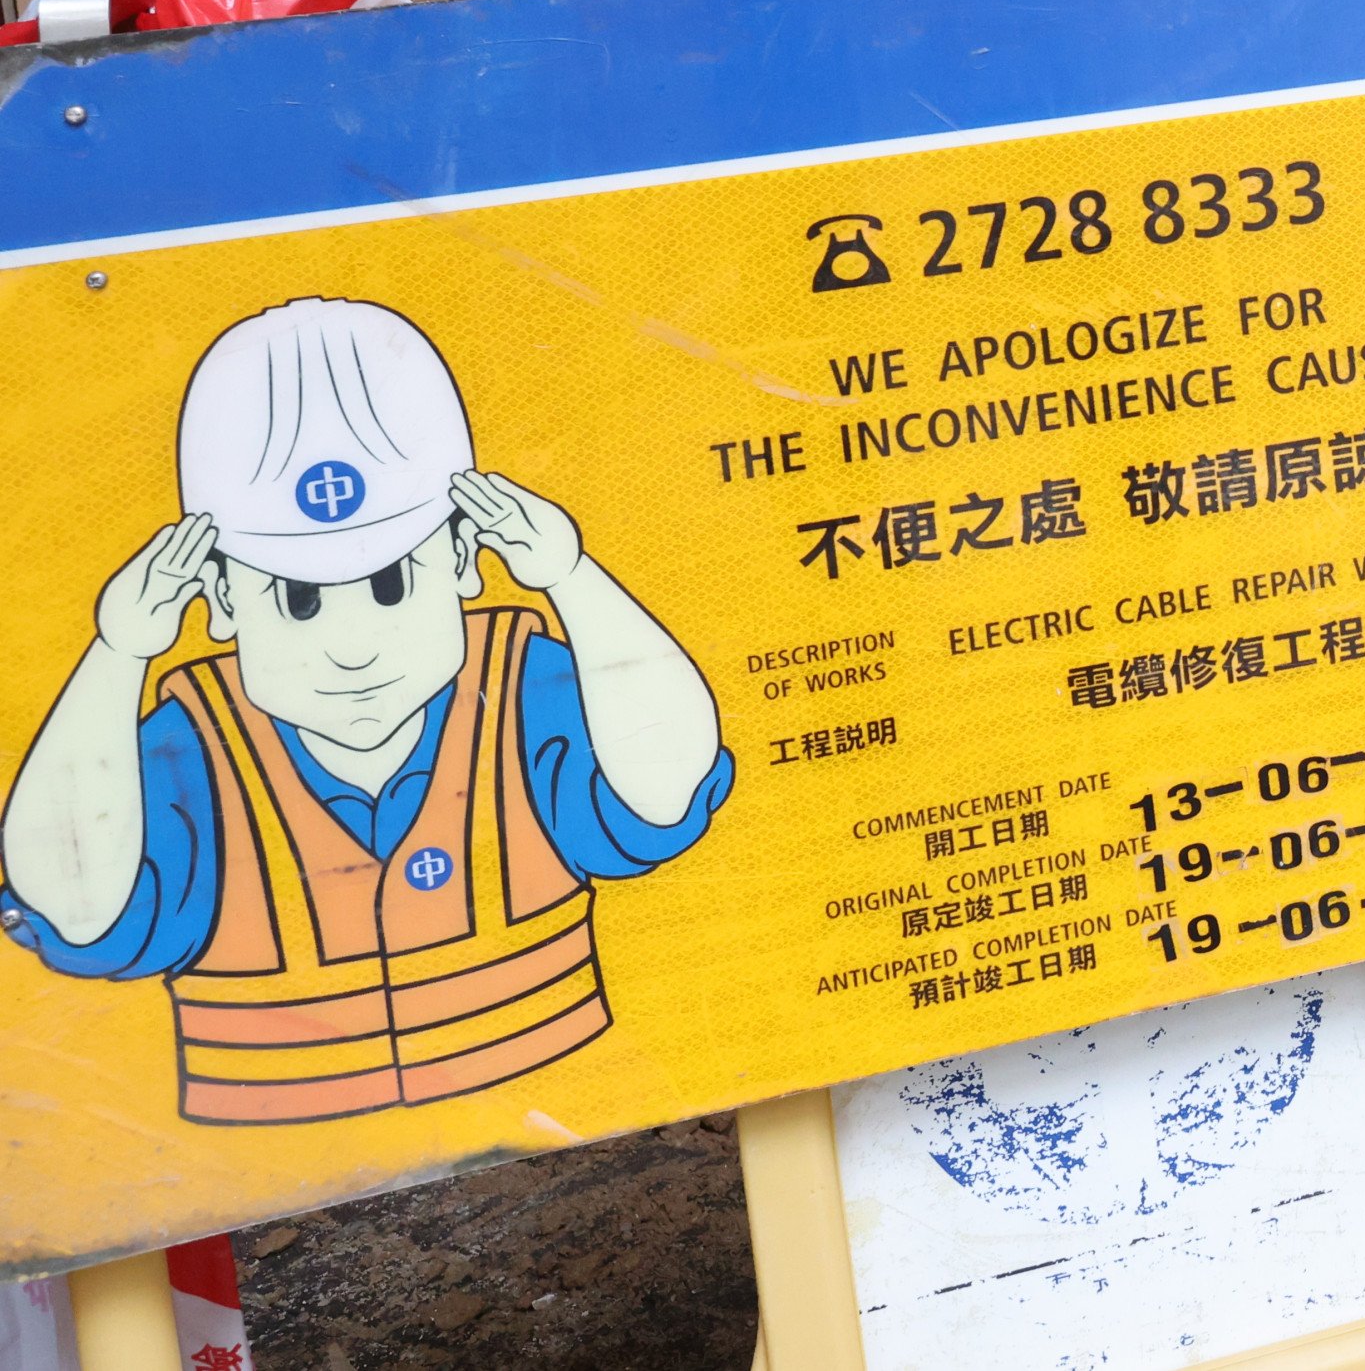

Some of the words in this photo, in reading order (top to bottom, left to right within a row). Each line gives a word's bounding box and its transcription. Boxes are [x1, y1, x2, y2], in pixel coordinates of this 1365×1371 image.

[919, 190, 1112, 277] 2728
[1142, 160, 1326, 245] 8333
[830, 349, 908, 396] WE
[939, 305, 1205, 381] APOLOGIZE
[1238, 288, 1326, 336] FOR
[710, 432, 805, 483] THE
[840, 364, 1235, 464] INCONVENIENCE
[798, 478, 1088, 581] 不便之處
[747, 630, 896, 673] DESCRIPTION
[949, 606, 1093, 656] ELECTRIC
[1115, 584, 1211, 626] CABLE
[1232, 563, 1336, 604] REPAIR
[763, 678, 794, 700] OF
[806, 661, 887, 694] WORKS
[853, 787, 1044, 839] COMMENCEMENT
[1060, 771, 1111, 797] DATE
[924, 811, 1050, 860] 開工日期
[826, 884, 930, 920] ORIGINAL
[946, 850, 1086, 893] COMPLETION
[1101, 835, 1152, 862] DATE
[902, 875, 1088, 939] 原定竣工日期
[817, 949, 957, 996] ANTICIPATED
[973, 914, 1112, 959] COMPLETION
[1126, 900, 1177, 928] DATE
[910, 946, 1097, 1010] 預計竣工日期
